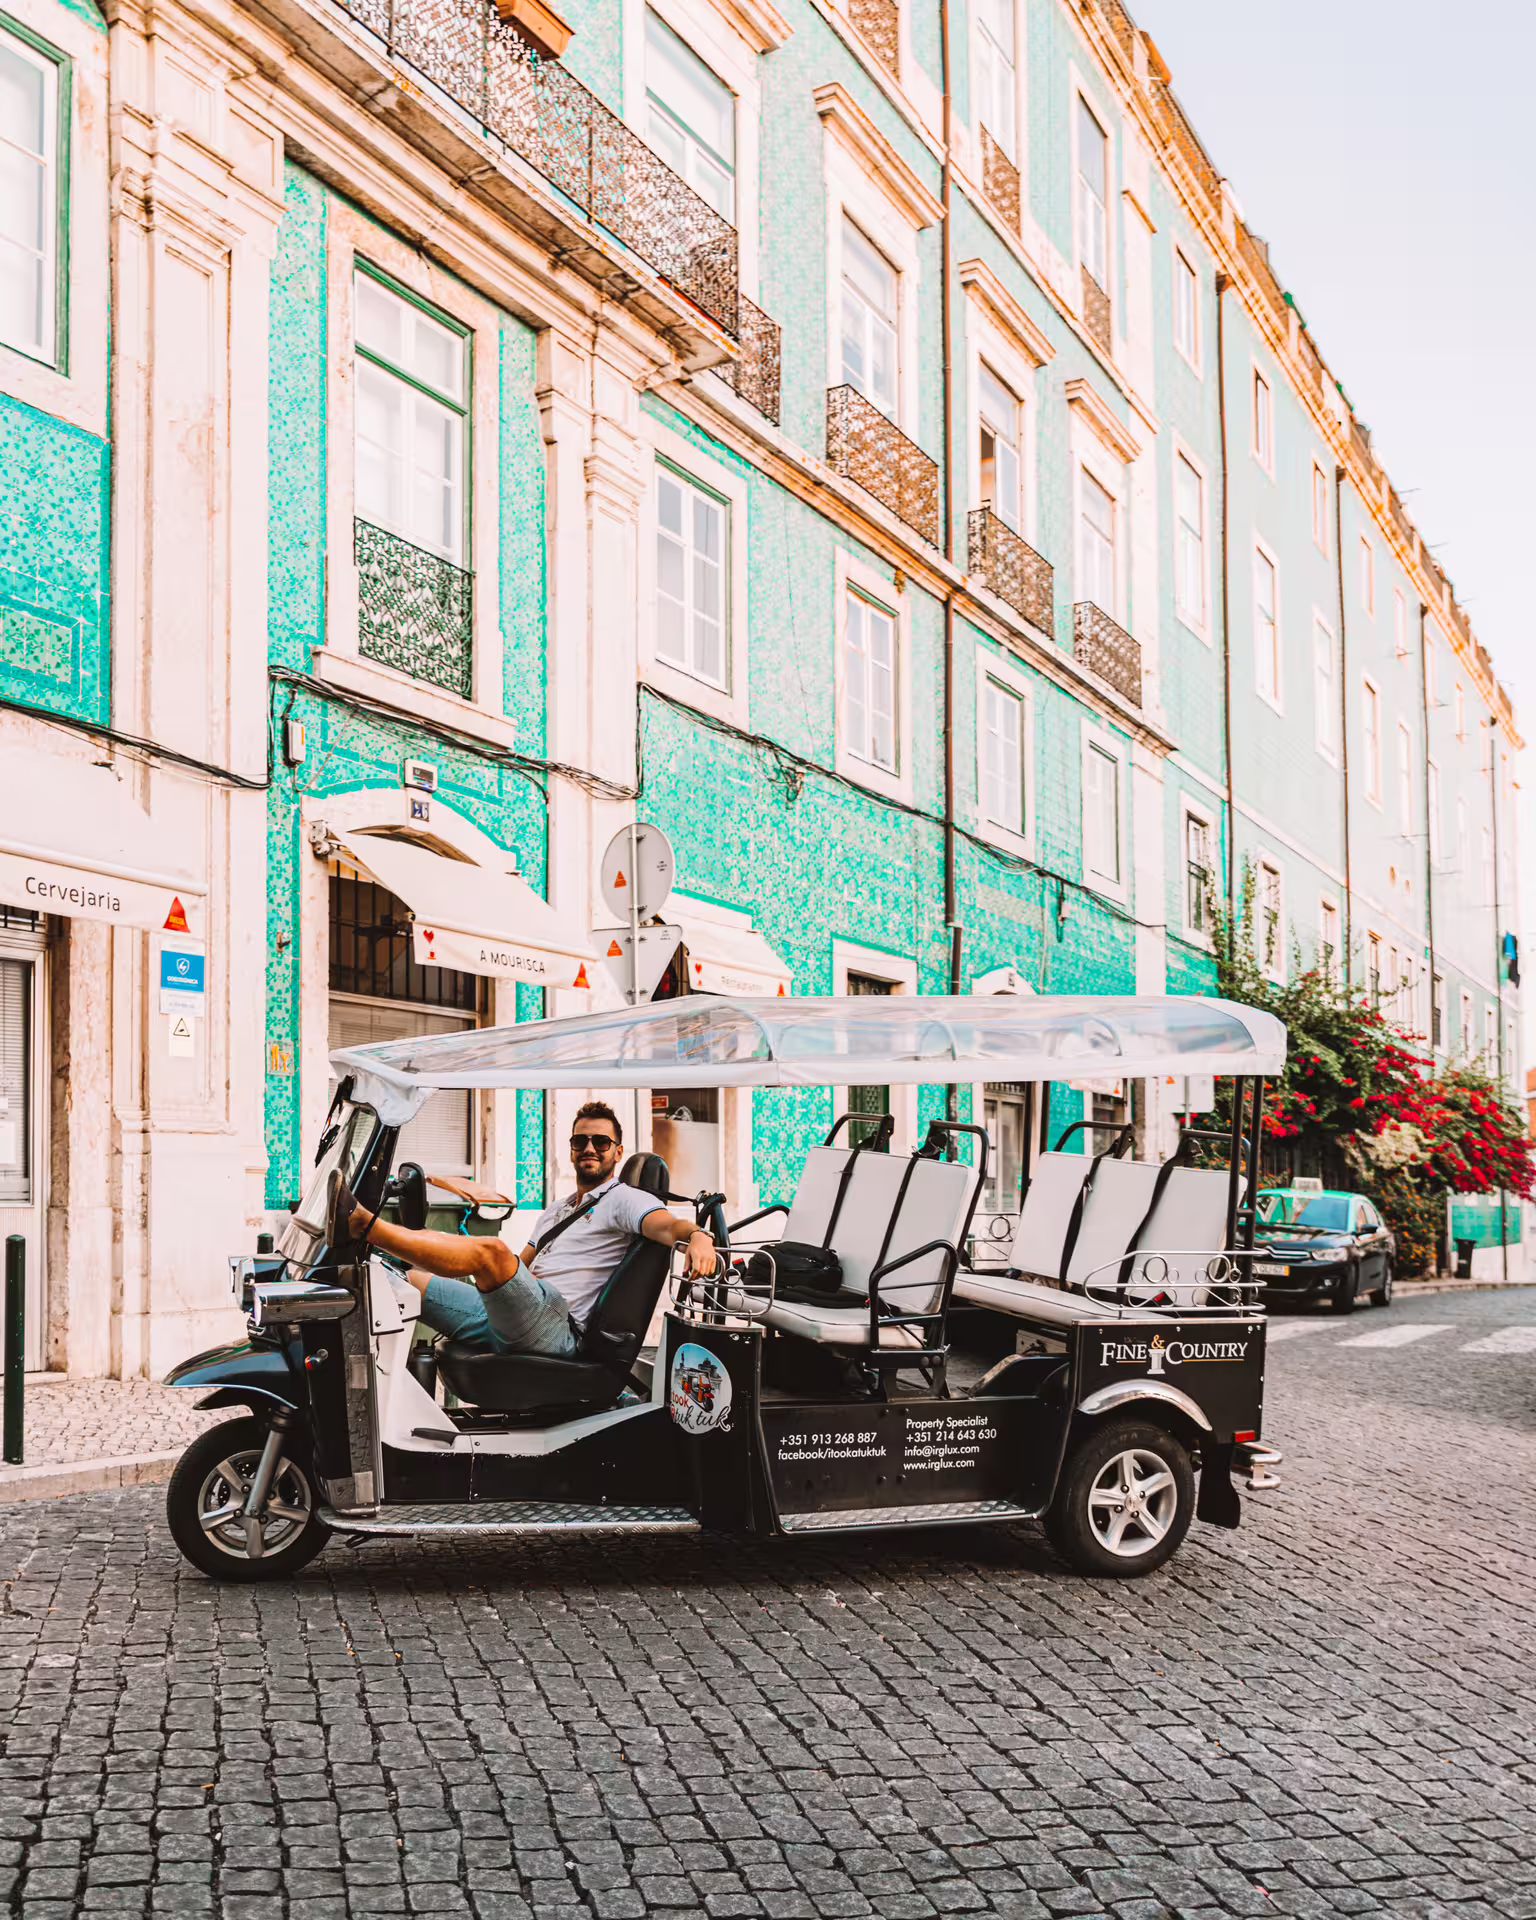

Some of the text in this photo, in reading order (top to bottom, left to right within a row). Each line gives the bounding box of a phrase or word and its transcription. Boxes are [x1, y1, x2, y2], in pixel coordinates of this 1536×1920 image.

[25, 876, 120, 912] Cervejaria
[480, 949, 545, 974] A MOURISCA
[1100, 1334, 1248, 1367] FINE & COUNTRY
[696, 1405, 731, 1432] tuk
[906, 1415, 988, 1431] Property Specialist
[780, 1432, 877, 1446] +351 913 268 887
[906, 1428, 997, 1443] +351 214 643 630
[778, 1445, 887, 1460] facebook/itookatuktuk
[904, 1443, 980, 1457] info@irglux.com
[903, 1458, 975, 1472] www.irglux.com
